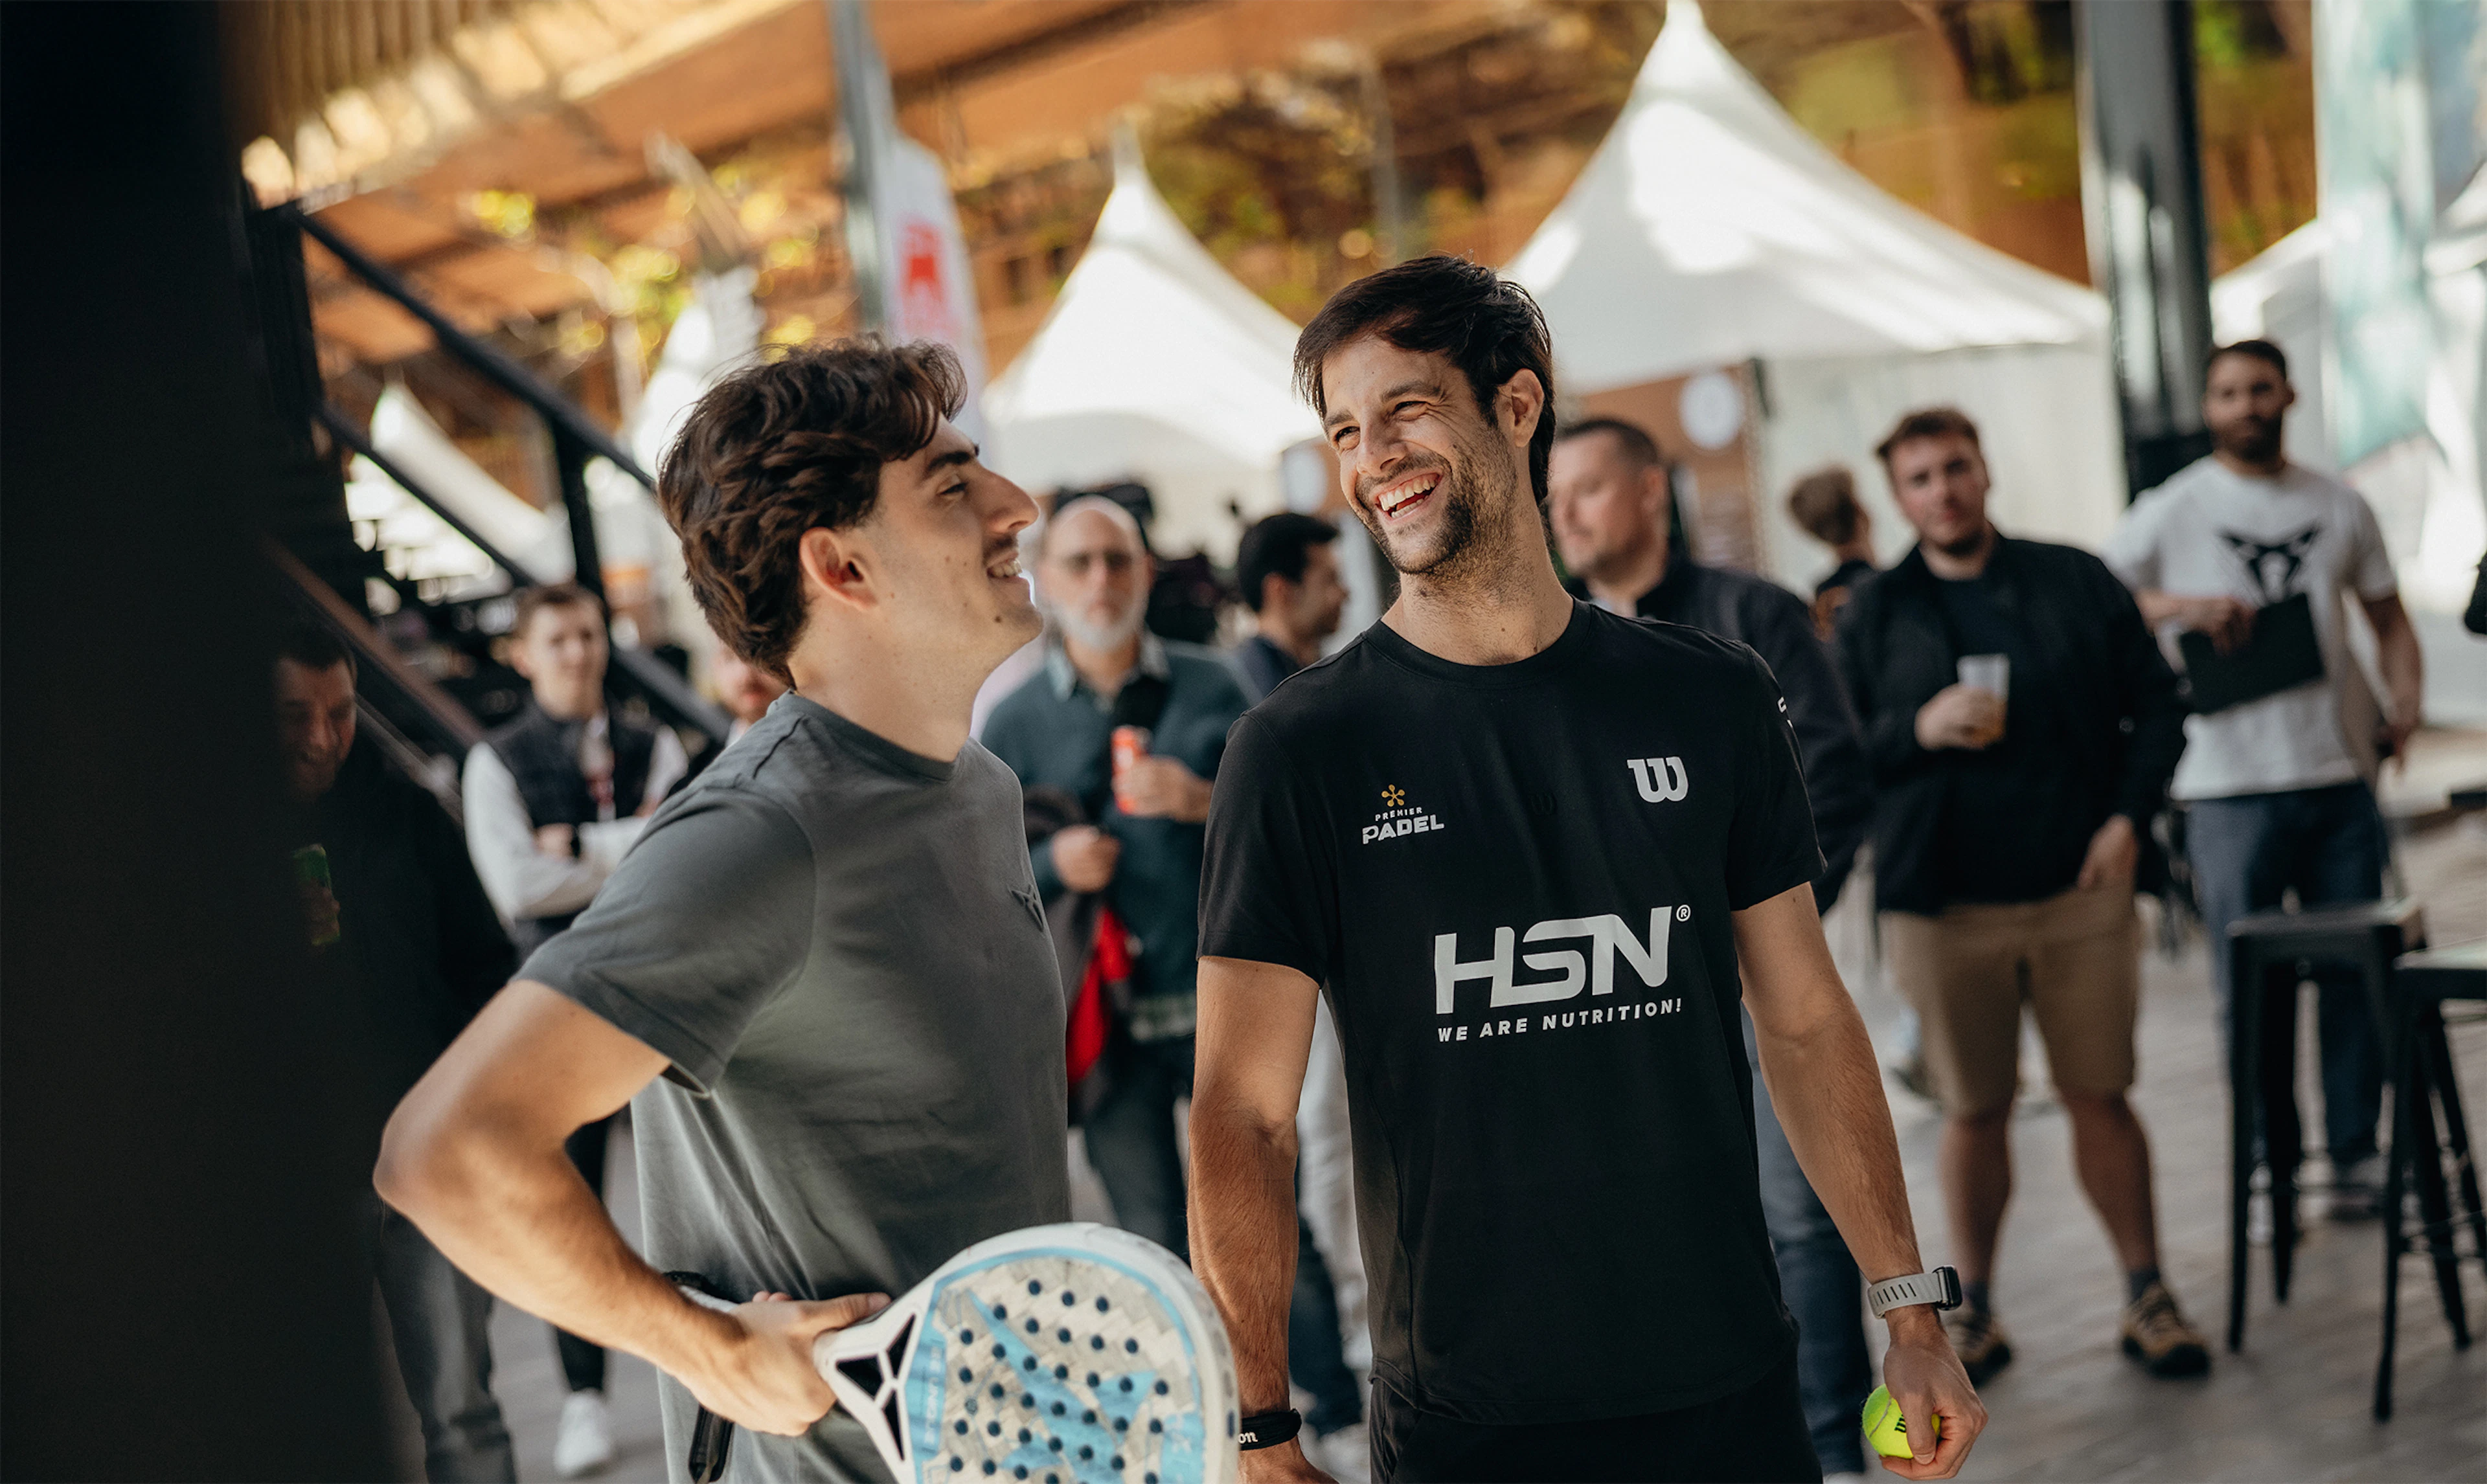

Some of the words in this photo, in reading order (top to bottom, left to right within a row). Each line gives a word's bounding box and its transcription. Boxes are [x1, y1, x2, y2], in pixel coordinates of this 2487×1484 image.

[1362, 814, 1445, 844] PADEL
[1375, 807, 1422, 822] PREMIER
[1438, 1026, 1468, 1042] WE
[1479, 1018, 1528, 1038] ARE
[1542, 998, 1681, 1031] NUTRITION!
